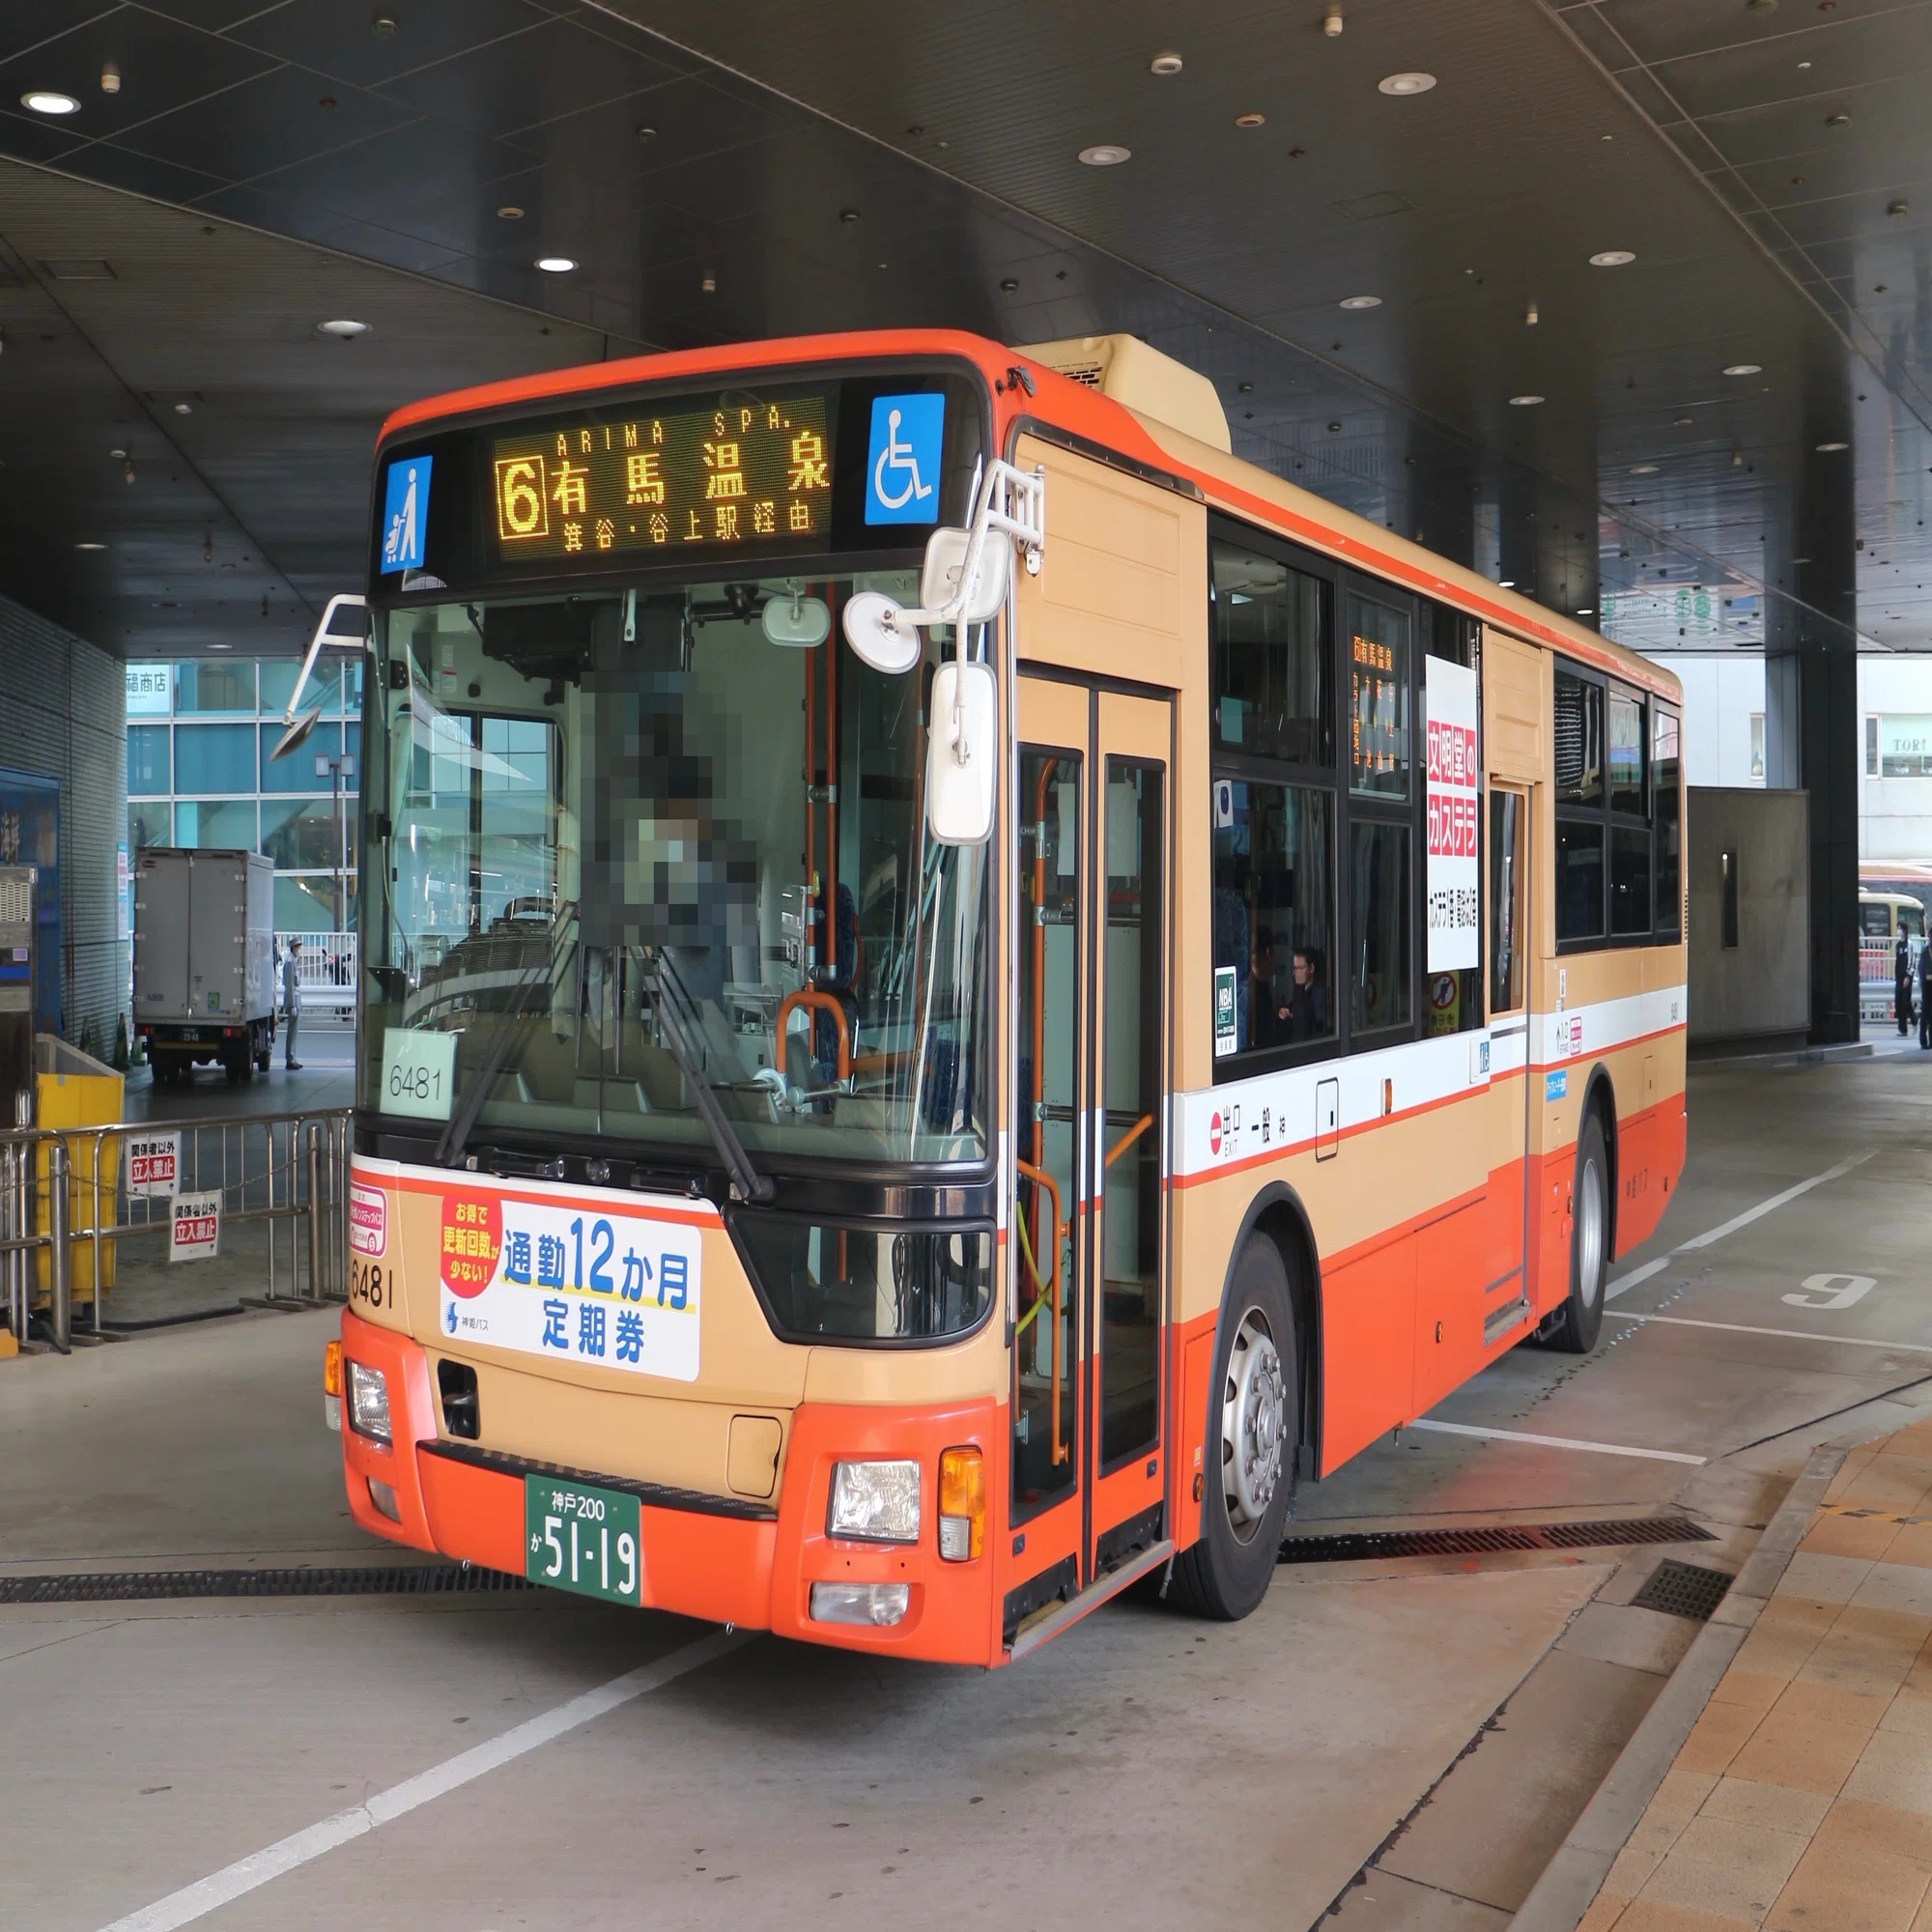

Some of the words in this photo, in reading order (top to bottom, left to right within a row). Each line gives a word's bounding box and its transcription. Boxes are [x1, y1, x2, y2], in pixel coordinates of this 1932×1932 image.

[557, 420, 663, 457] ARIMA
[503, 462, 540, 533] 6
[551, 432, 831, 514] 有馬温泉
[1429, 730, 1475, 779] 文明堂の
[1429, 801, 1475, 849] カステラ
[1219, 987, 1233, 1008] NBA
[389, 1065, 440, 1100] 6481
[1223, 1105, 1240, 1135] 出口
[131, 1141, 175, 1157] 関係者以外
[1225, 1139, 1237, 1157] EXIT
[133, 1159, 173, 1180] 立入禁止
[175, 1203, 216, 1219] 関係者以外
[455, 1203, 488, 1225] お得で
[176, 1221, 215, 1242] 立入禁止
[443, 1225, 499, 1260] 更新回数が
[504, 1217, 688, 1310] 通勤12か月
[352, 1259, 392, 1309] 6481
[1781, 1273, 1878, 1309] 9
[462, 1317, 489, 1332] 神姫バス
[542, 1297, 645, 1363] 定期券
[530, 1532, 542, 1553] か
